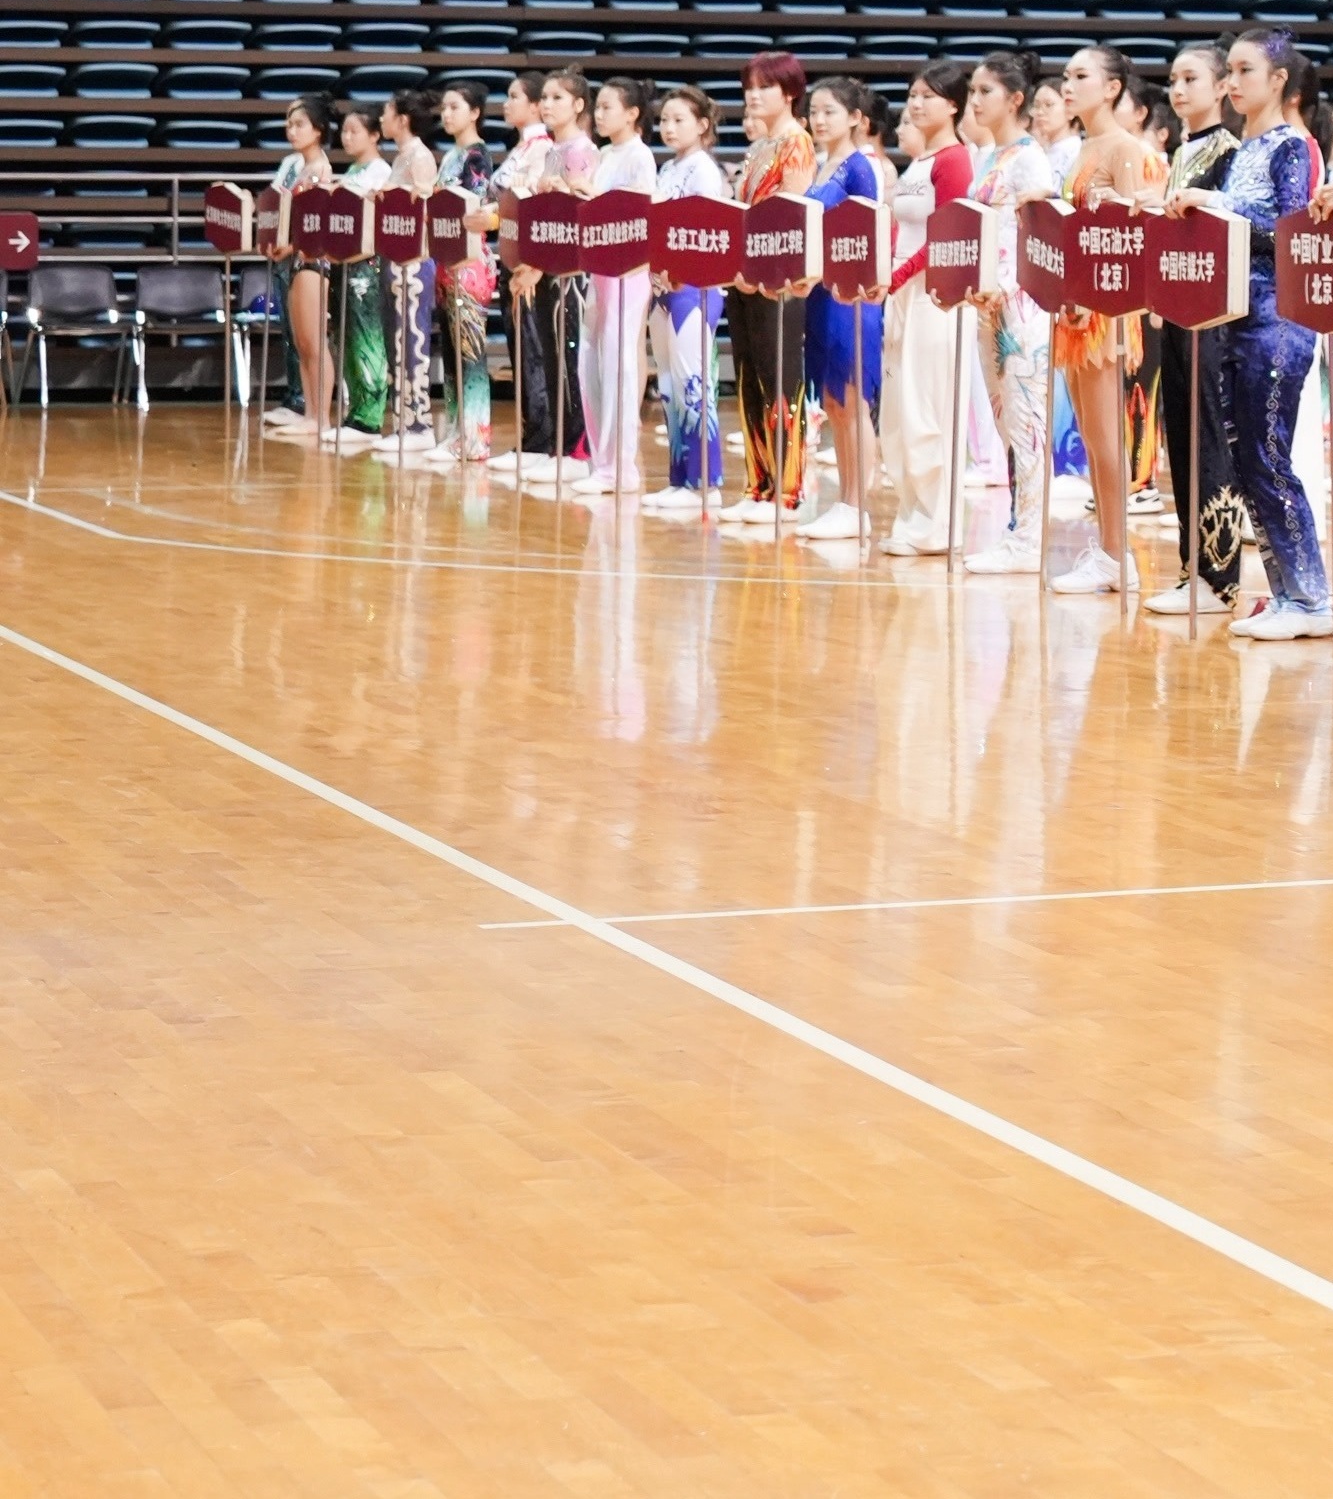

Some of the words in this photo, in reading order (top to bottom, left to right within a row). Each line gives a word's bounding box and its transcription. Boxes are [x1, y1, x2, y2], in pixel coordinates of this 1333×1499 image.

[667, 227, 730, 255] 北京工业大学
[831, 235, 868, 262] 北京理工大学
[1079, 226, 1145, 256] 中国石油大学
[1159, 250, 1215, 282] 中国传媒大学
